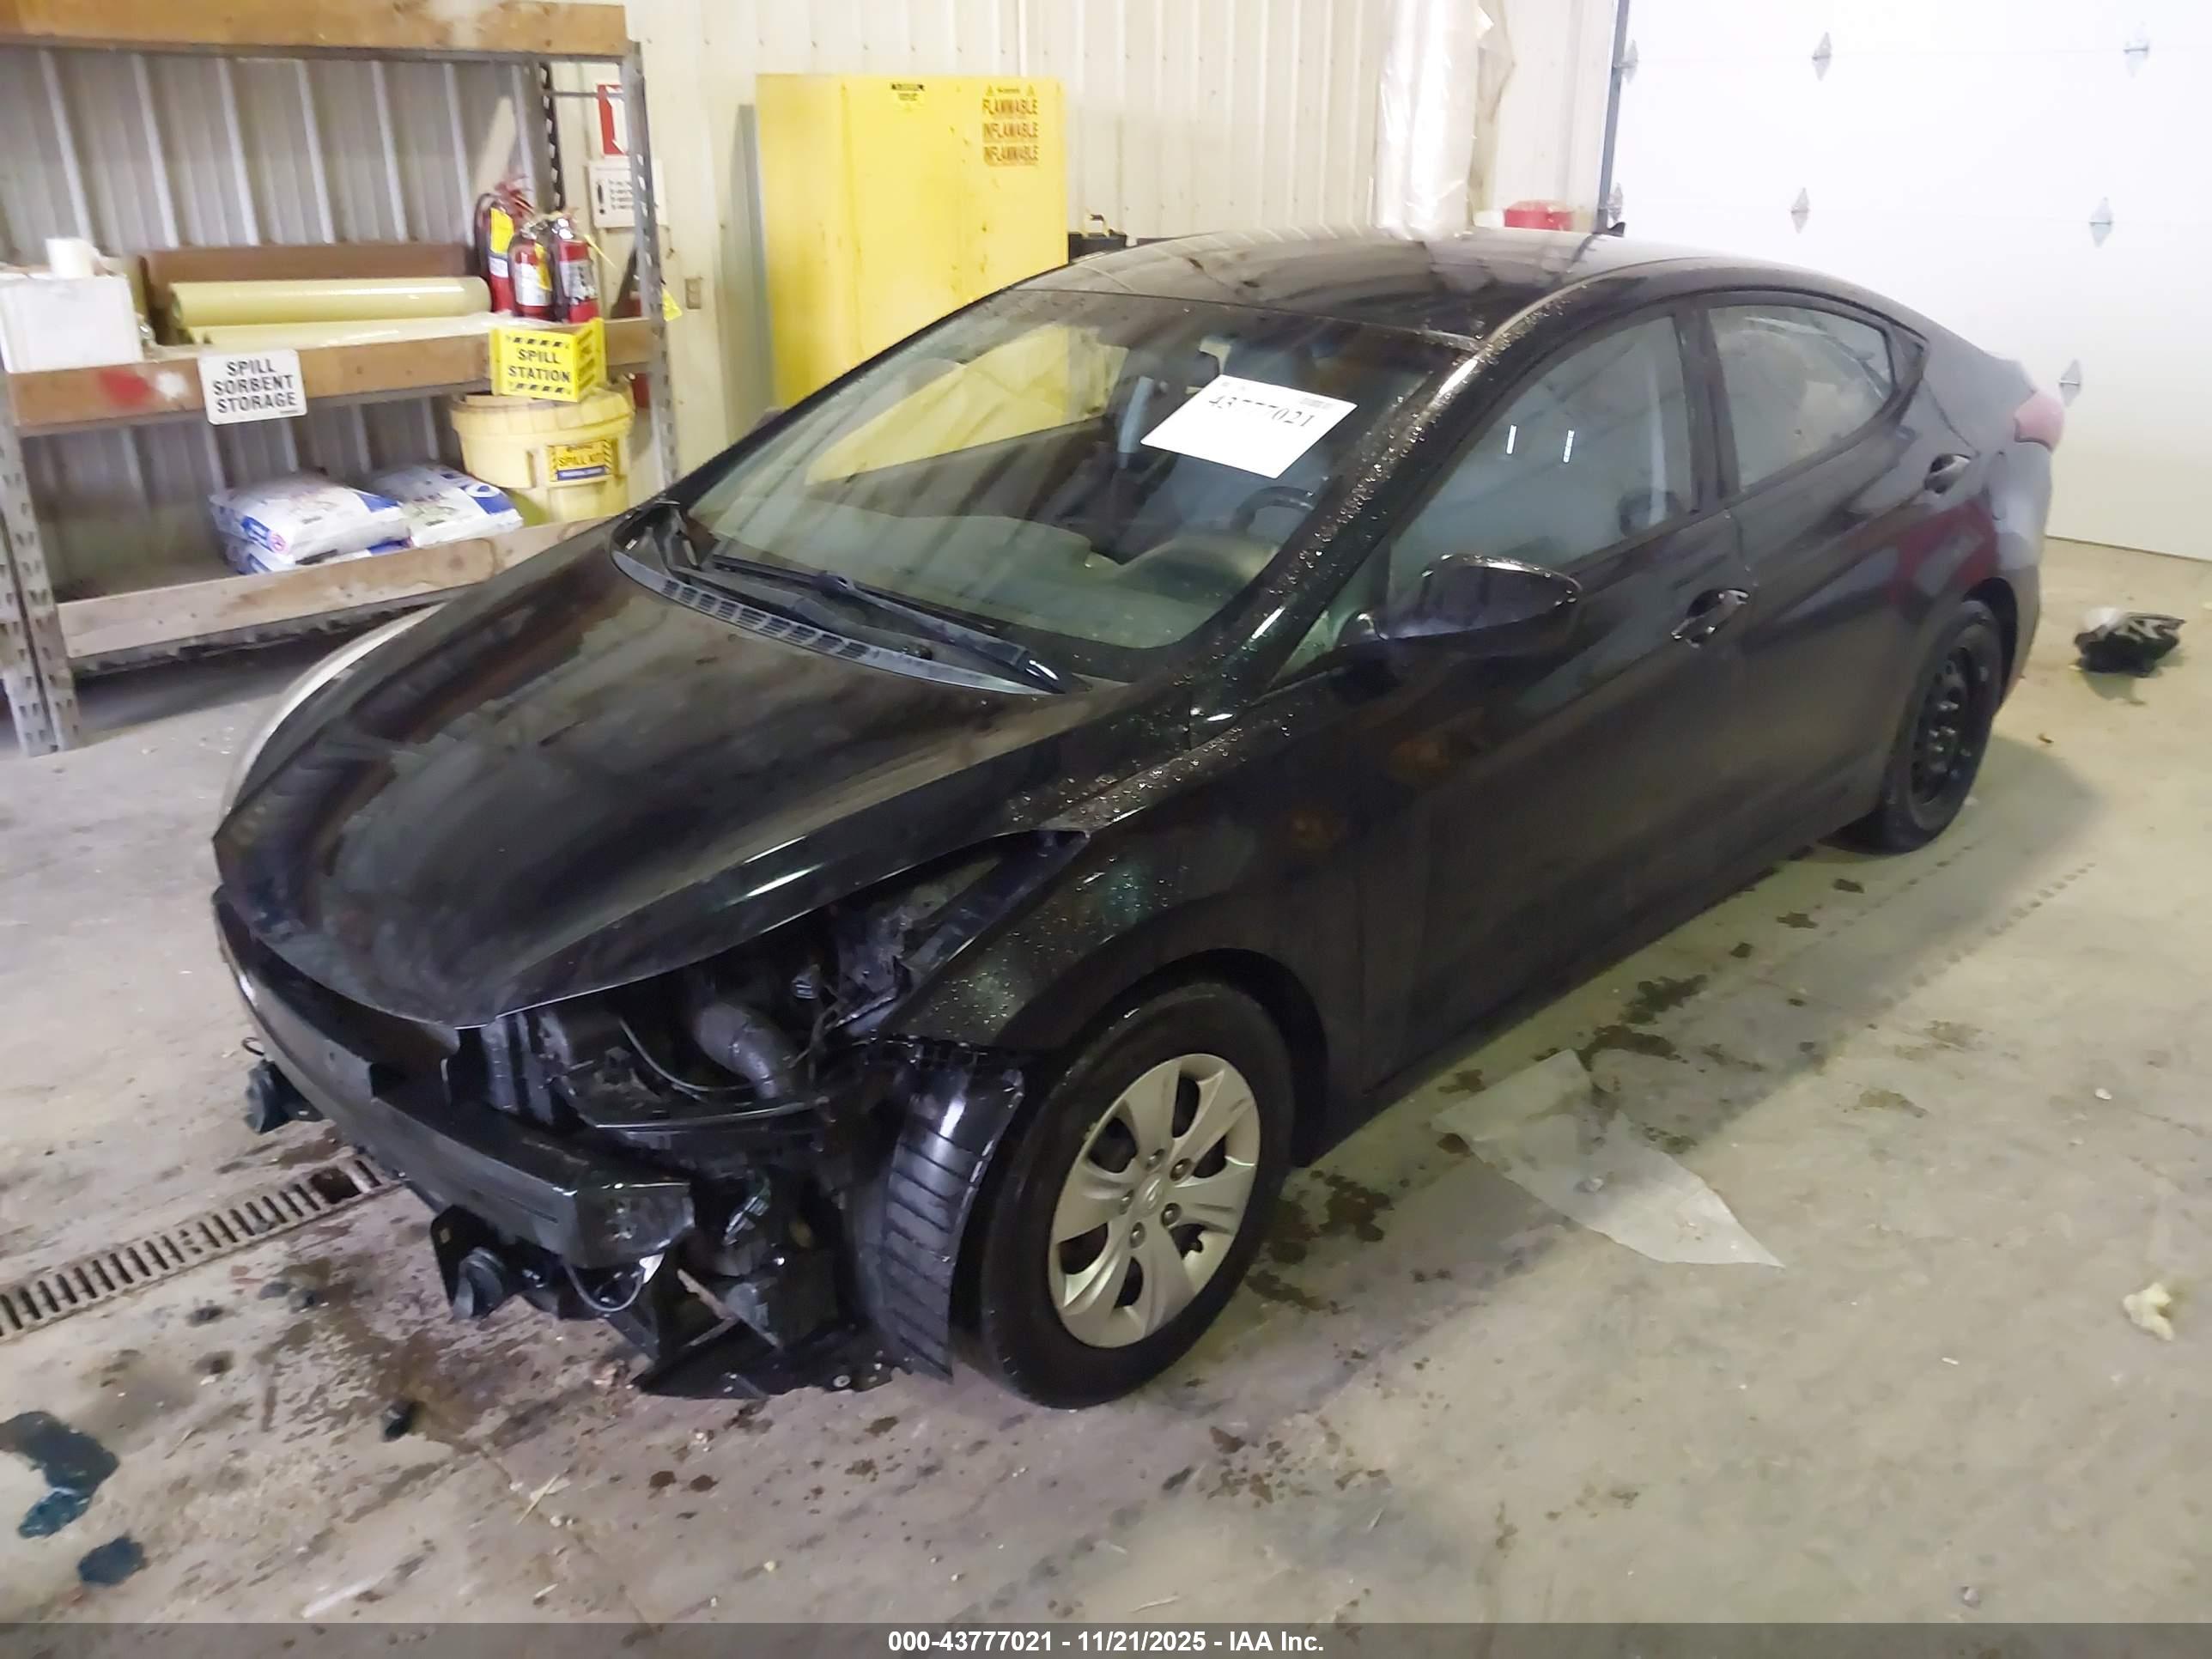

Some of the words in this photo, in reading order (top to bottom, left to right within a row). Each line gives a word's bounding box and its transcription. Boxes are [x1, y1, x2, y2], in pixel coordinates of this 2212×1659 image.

[982, 98, 1037, 115] FLAMMABLE
[518, 349, 561, 364] SPILL
[227, 359, 276, 376] SPILL
[508, 366, 570, 383] STATION
[213, 374, 294, 395] SORBENT
[216, 392, 297, 413] STORAGE
